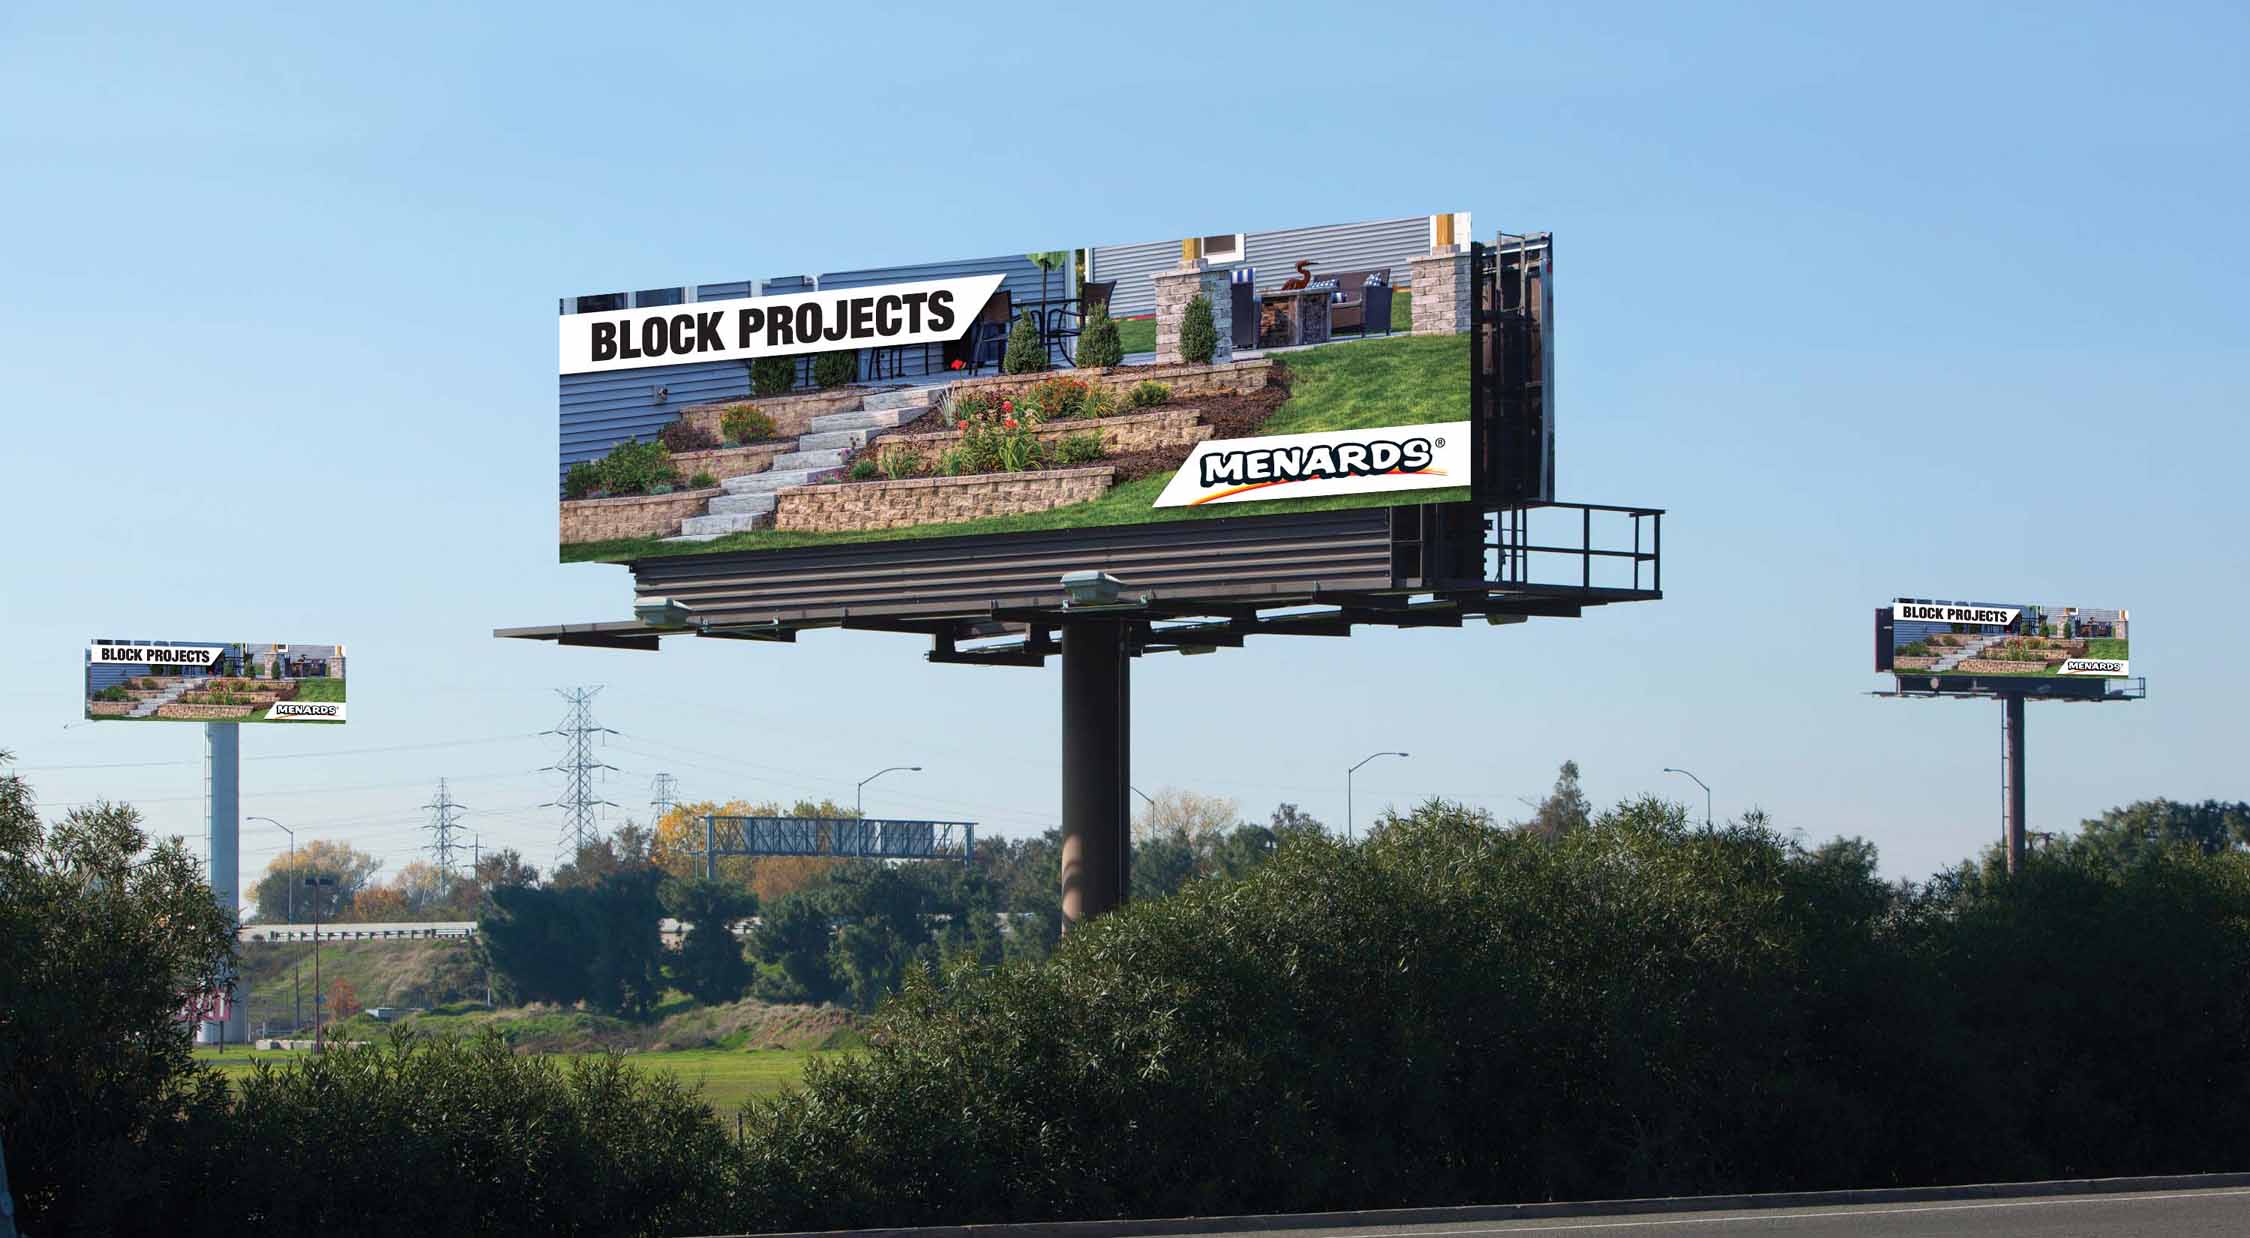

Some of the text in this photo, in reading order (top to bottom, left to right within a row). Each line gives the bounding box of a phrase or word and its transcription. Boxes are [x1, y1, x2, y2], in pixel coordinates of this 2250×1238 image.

[591, 289, 955, 362] BLOCK PROJECTS
[1903, 606, 2008, 623] BLOCK PROJECTS
[101, 647, 210, 663] BLOCK PROJECTS
